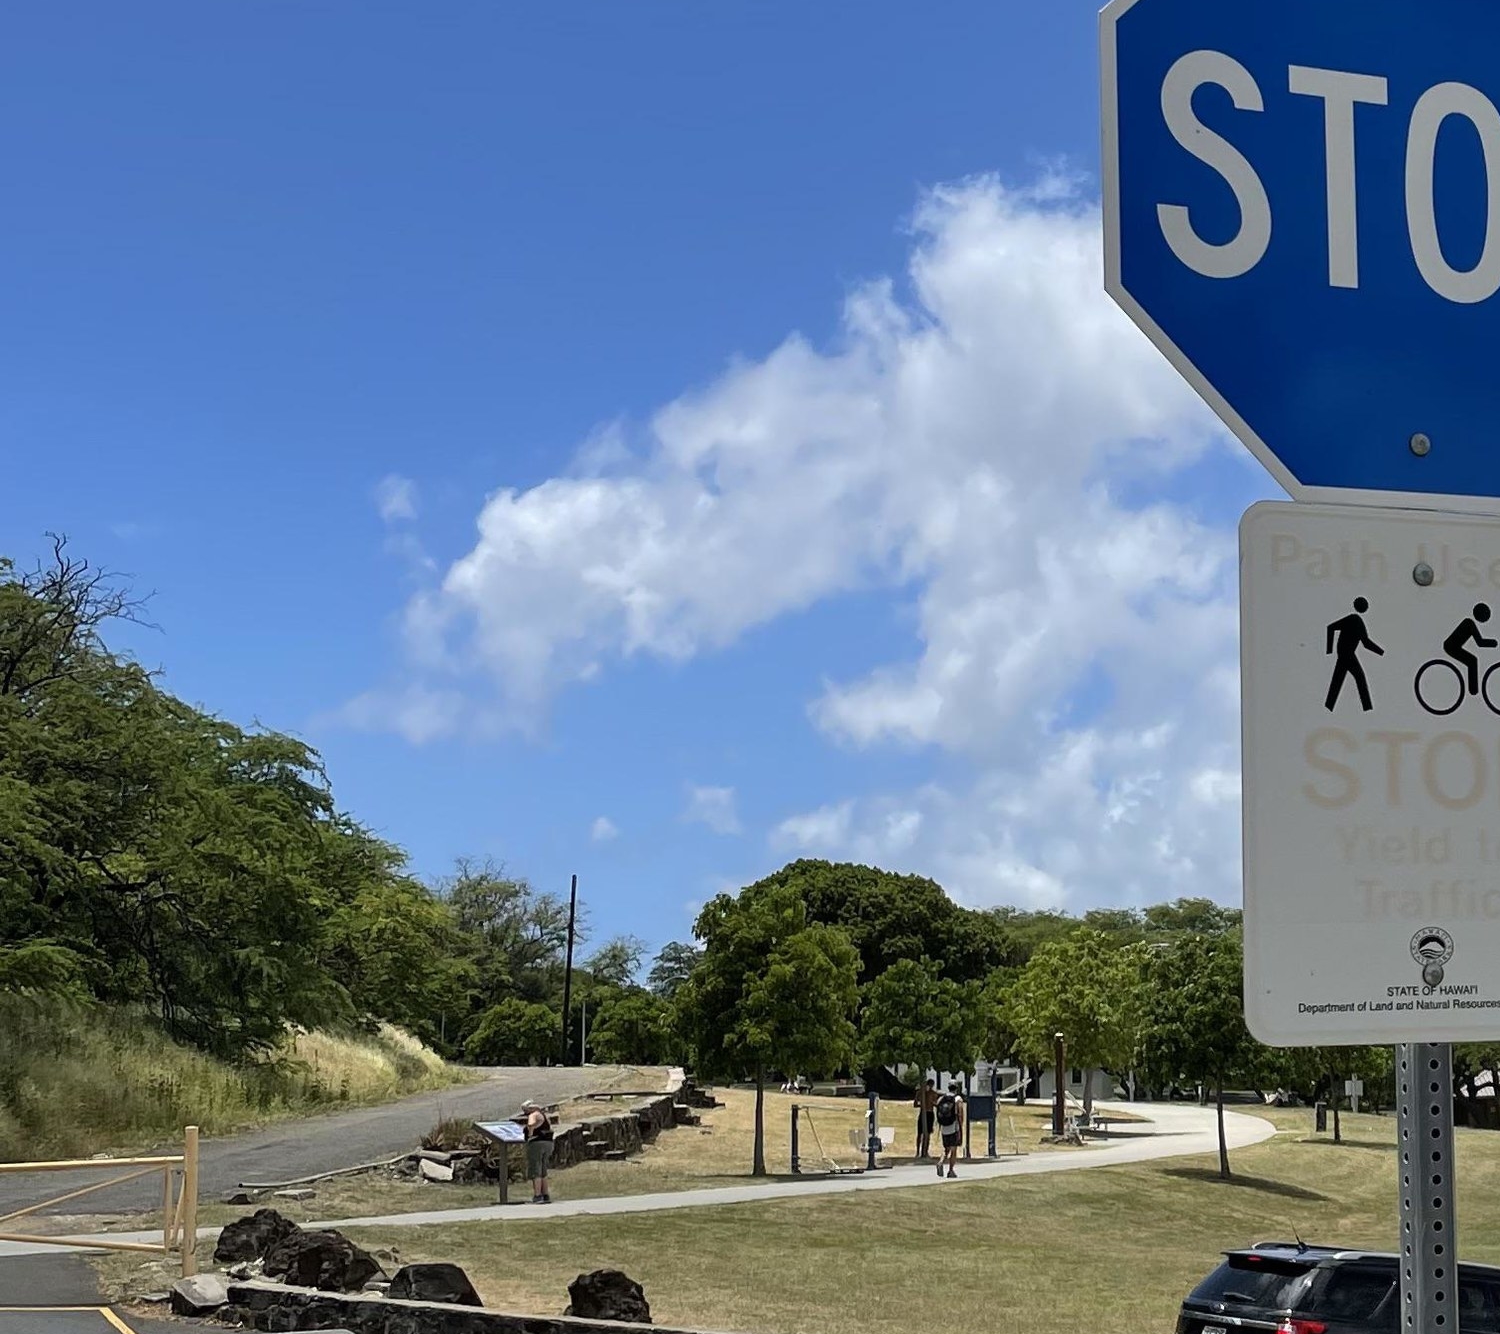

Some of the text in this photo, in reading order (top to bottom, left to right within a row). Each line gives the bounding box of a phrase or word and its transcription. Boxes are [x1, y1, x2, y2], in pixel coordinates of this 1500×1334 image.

[1269, 532, 1389, 583] Path
[1334, 825, 1452, 866] Yield
[1387, 986, 1419, 997] STATE
[1422, 986, 1437, 996] OF
[1298, 1002, 1355, 1015] Department
[1357, 1001, 1367, 1012] of
[1370, 1001, 1393, 1011] Land
[1396, 1000, 1413, 1010] and
[1416, 999, 1450, 1010] Natural
